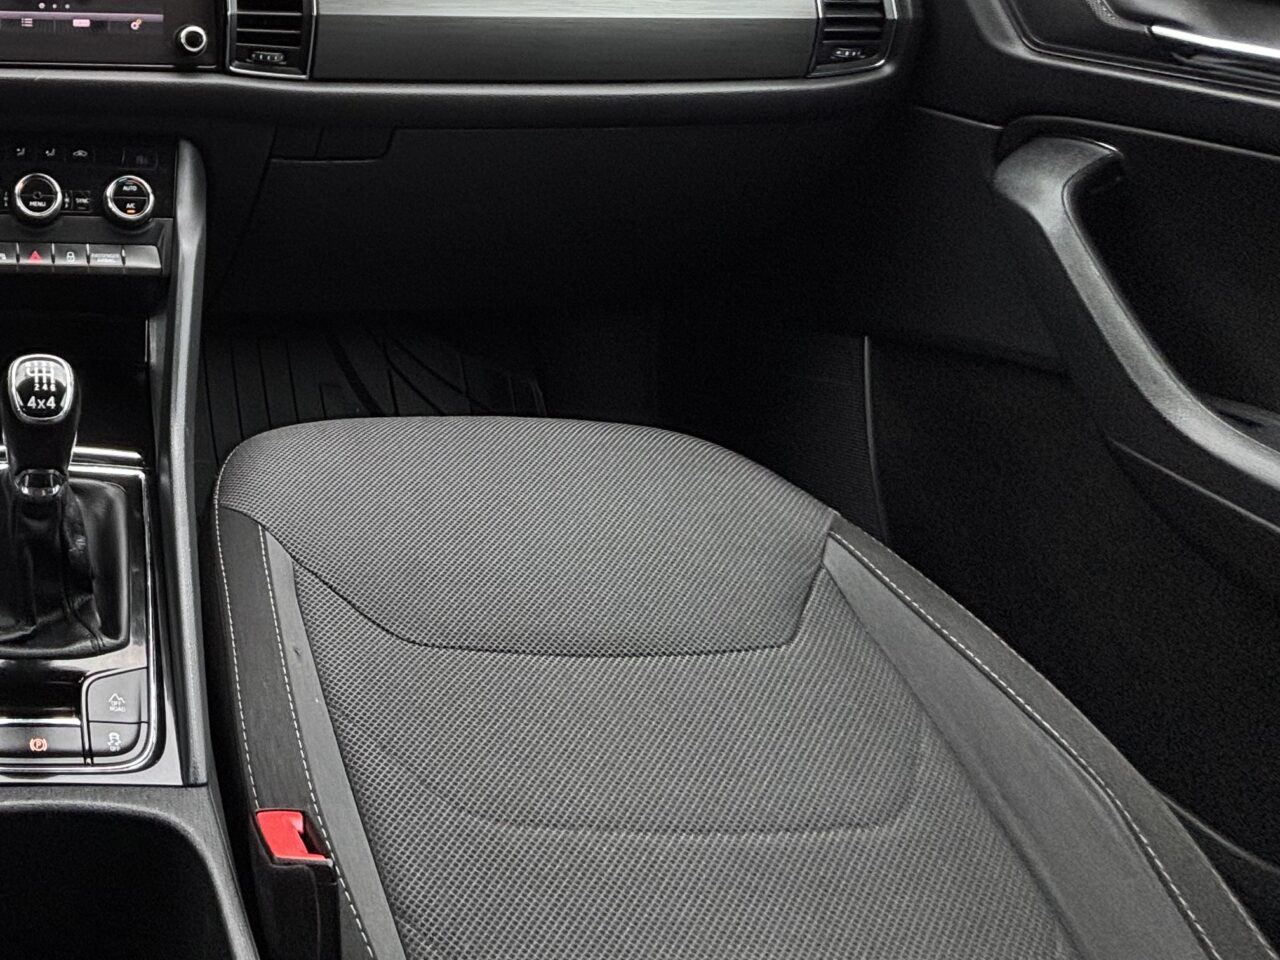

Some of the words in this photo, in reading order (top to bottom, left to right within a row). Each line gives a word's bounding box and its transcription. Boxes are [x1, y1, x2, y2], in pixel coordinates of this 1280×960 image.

[34, 383, 40, 391] 2
[42, 383, 49, 391] 4
[27, 395, 56, 409] 4x4
